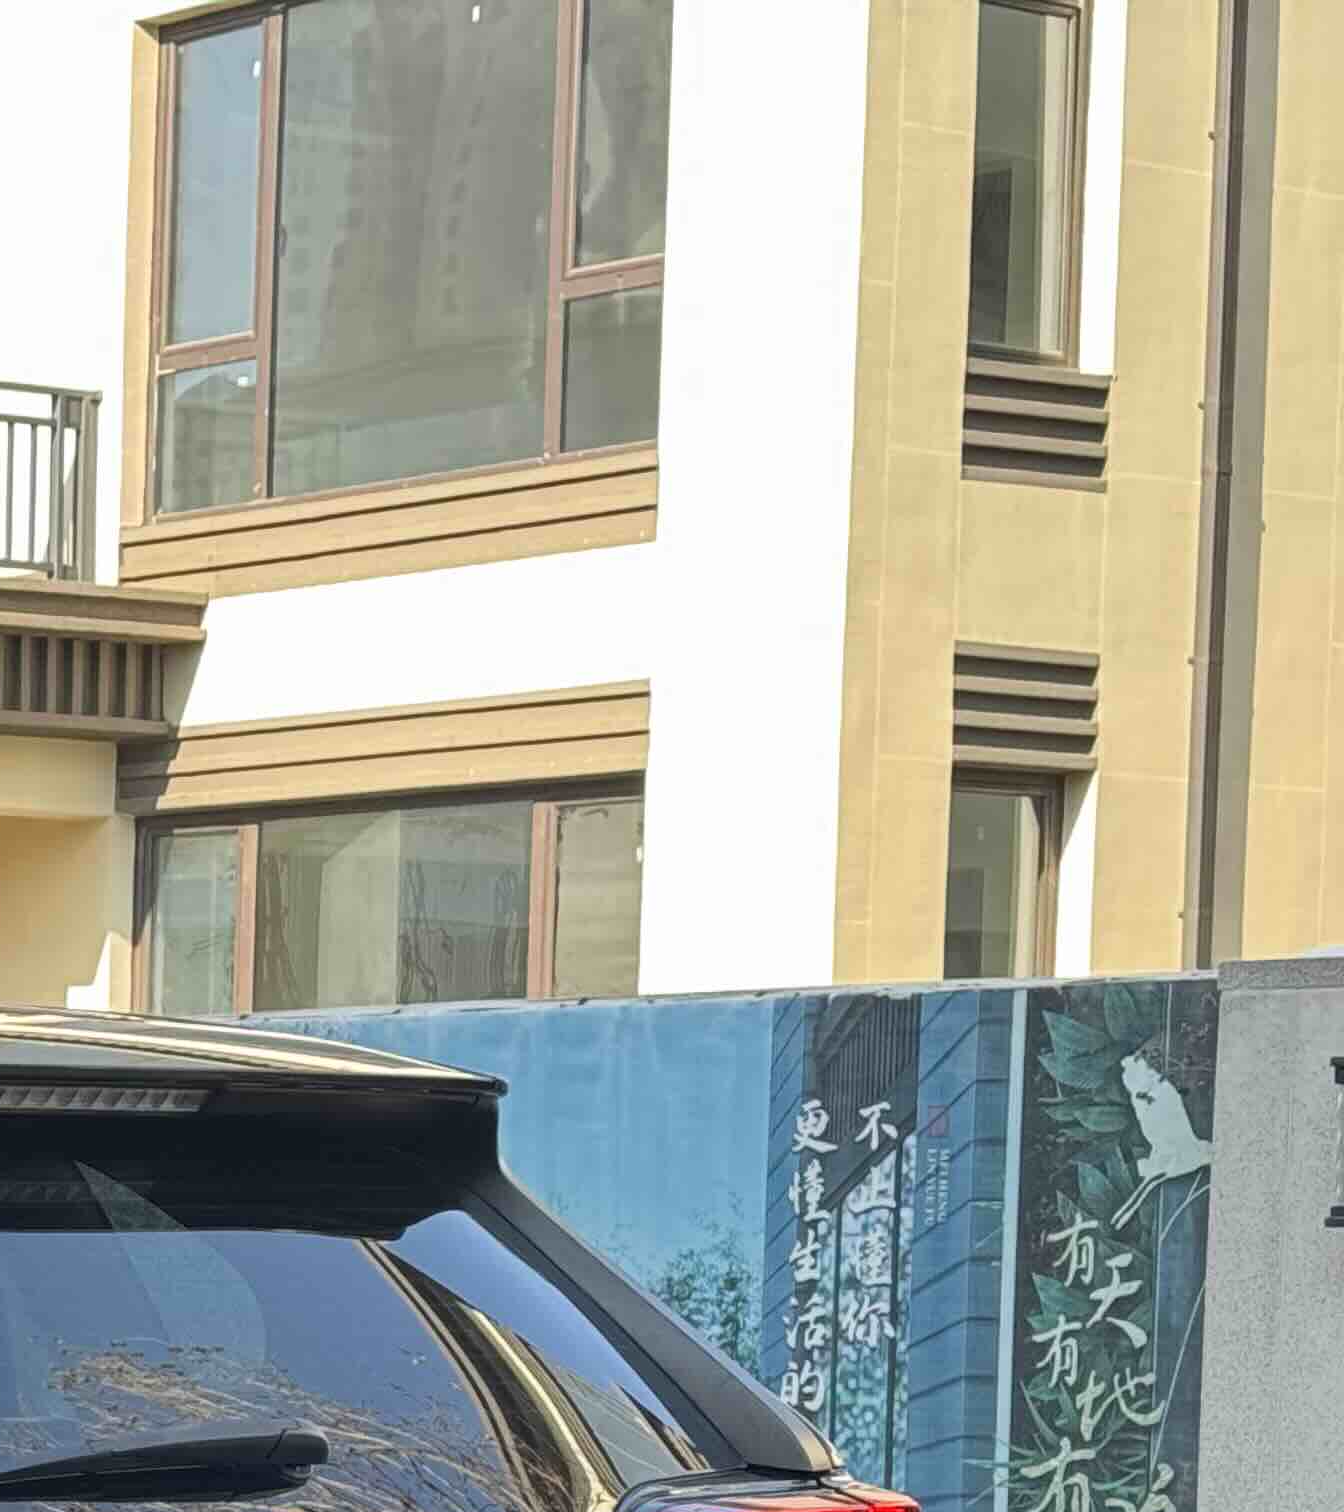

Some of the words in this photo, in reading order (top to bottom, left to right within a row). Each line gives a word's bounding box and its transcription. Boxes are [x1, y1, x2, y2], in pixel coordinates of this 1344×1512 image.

[779, 1098, 840, 1412] 更懂生活的
[838, 1100, 900, 1348] 不止懂你
